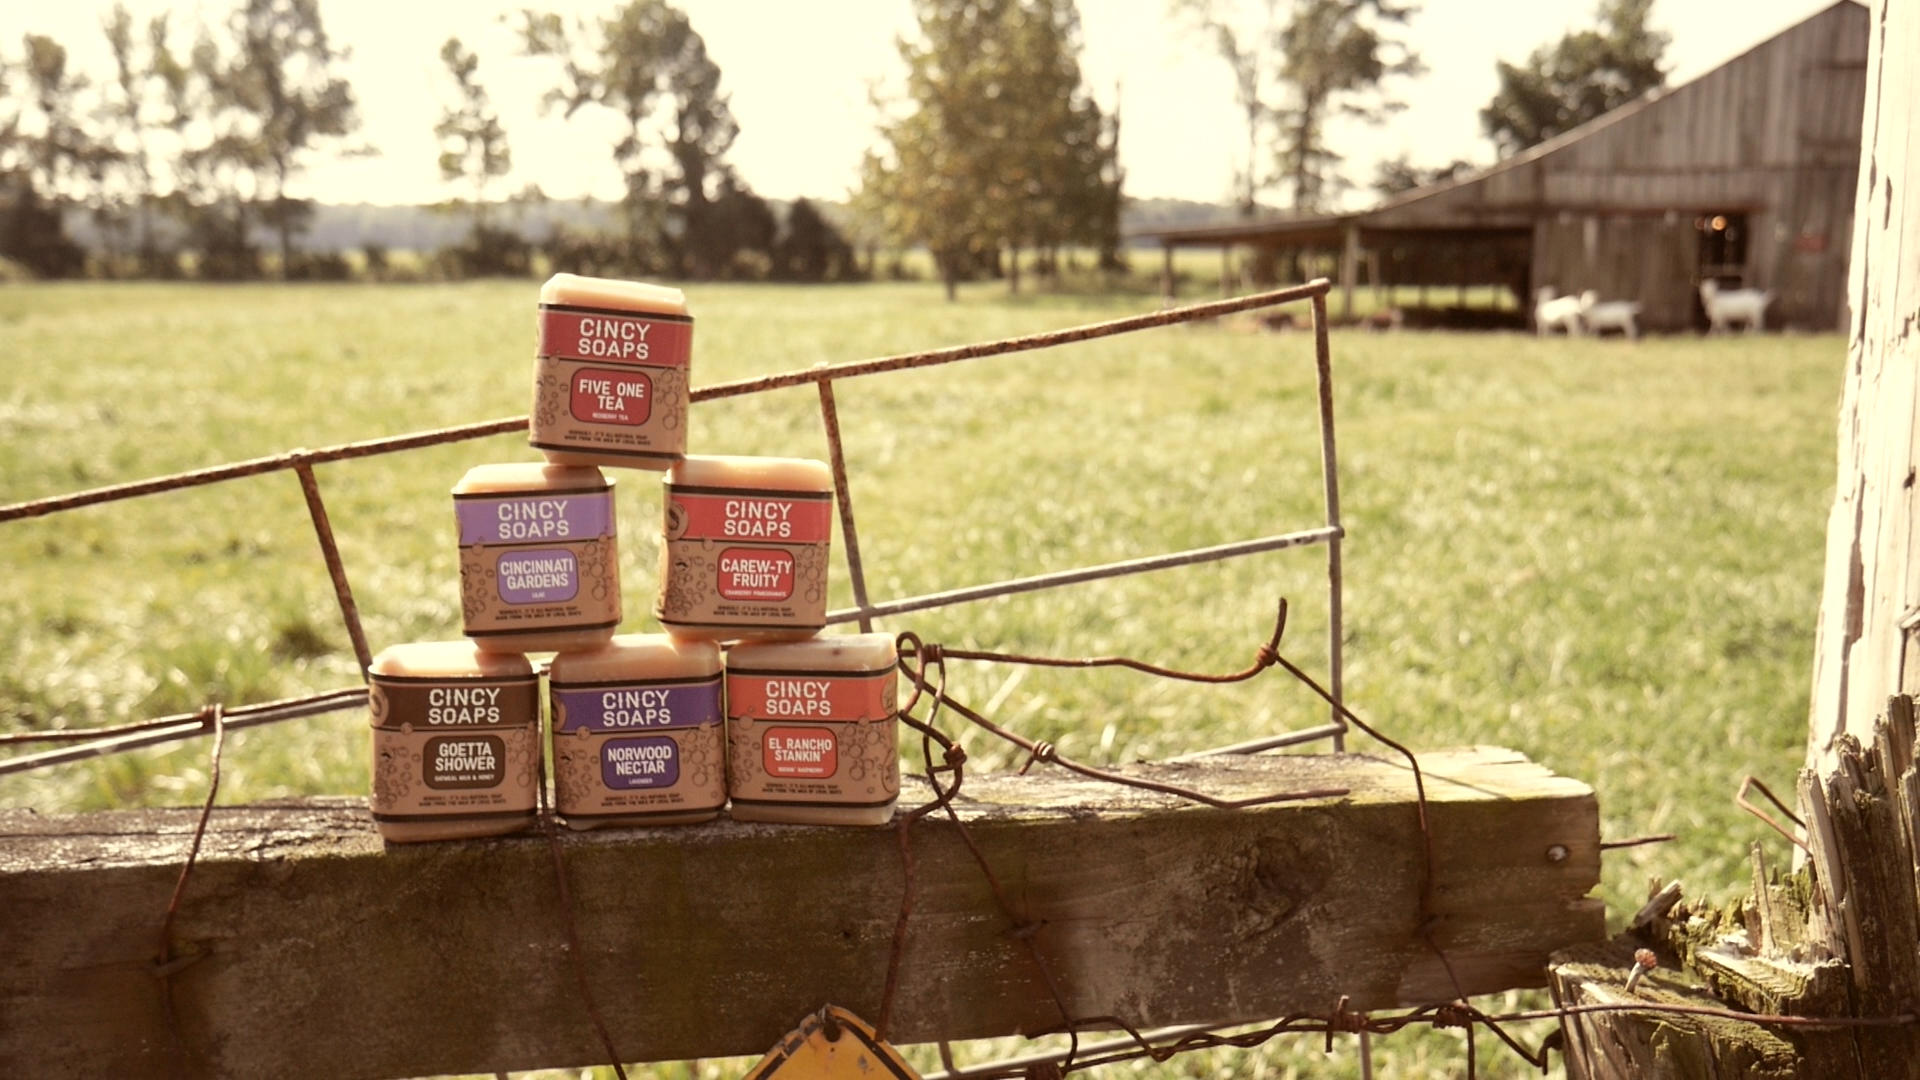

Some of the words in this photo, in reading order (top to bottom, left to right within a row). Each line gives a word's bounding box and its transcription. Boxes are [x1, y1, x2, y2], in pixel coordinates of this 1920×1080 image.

[580, 318, 650, 341] CINCY
[578, 338, 648, 360] SOAPS
[579, 379, 610, 396] FIVE
[617, 382, 644, 398] ONE
[598, 395, 624, 410] TEA
[498, 500, 567, 520] CINCY
[726, 501, 792, 520] CINCY
[498, 520, 569, 539] SOAPS
[724, 520, 791, 538] SOAPS
[500, 558, 573, 576] CINCINNATI
[722, 559, 792, 574] CAREW-TY
[507, 574, 568, 590] GARDENS
[733, 574, 779, 587] FRUITY
[429, 688, 500, 706] CINCY
[766, 681, 830, 698] CINCY
[602, 690, 670, 709] CINCY
[766, 699, 831, 716] SOAPS
[428, 707, 499, 724] SOAPS
[603, 708, 671, 726] SOAPS
[439, 742, 492, 757] GOETTA
[769, 738, 782, 749] EL
[786, 738, 832, 751] RANCHO
[608, 746, 672, 762] NORWOOD
[775, 750, 826, 762] STANKIN'
[435, 756, 495, 772] SHOWER
[616, 761, 665, 775] NECTAR
